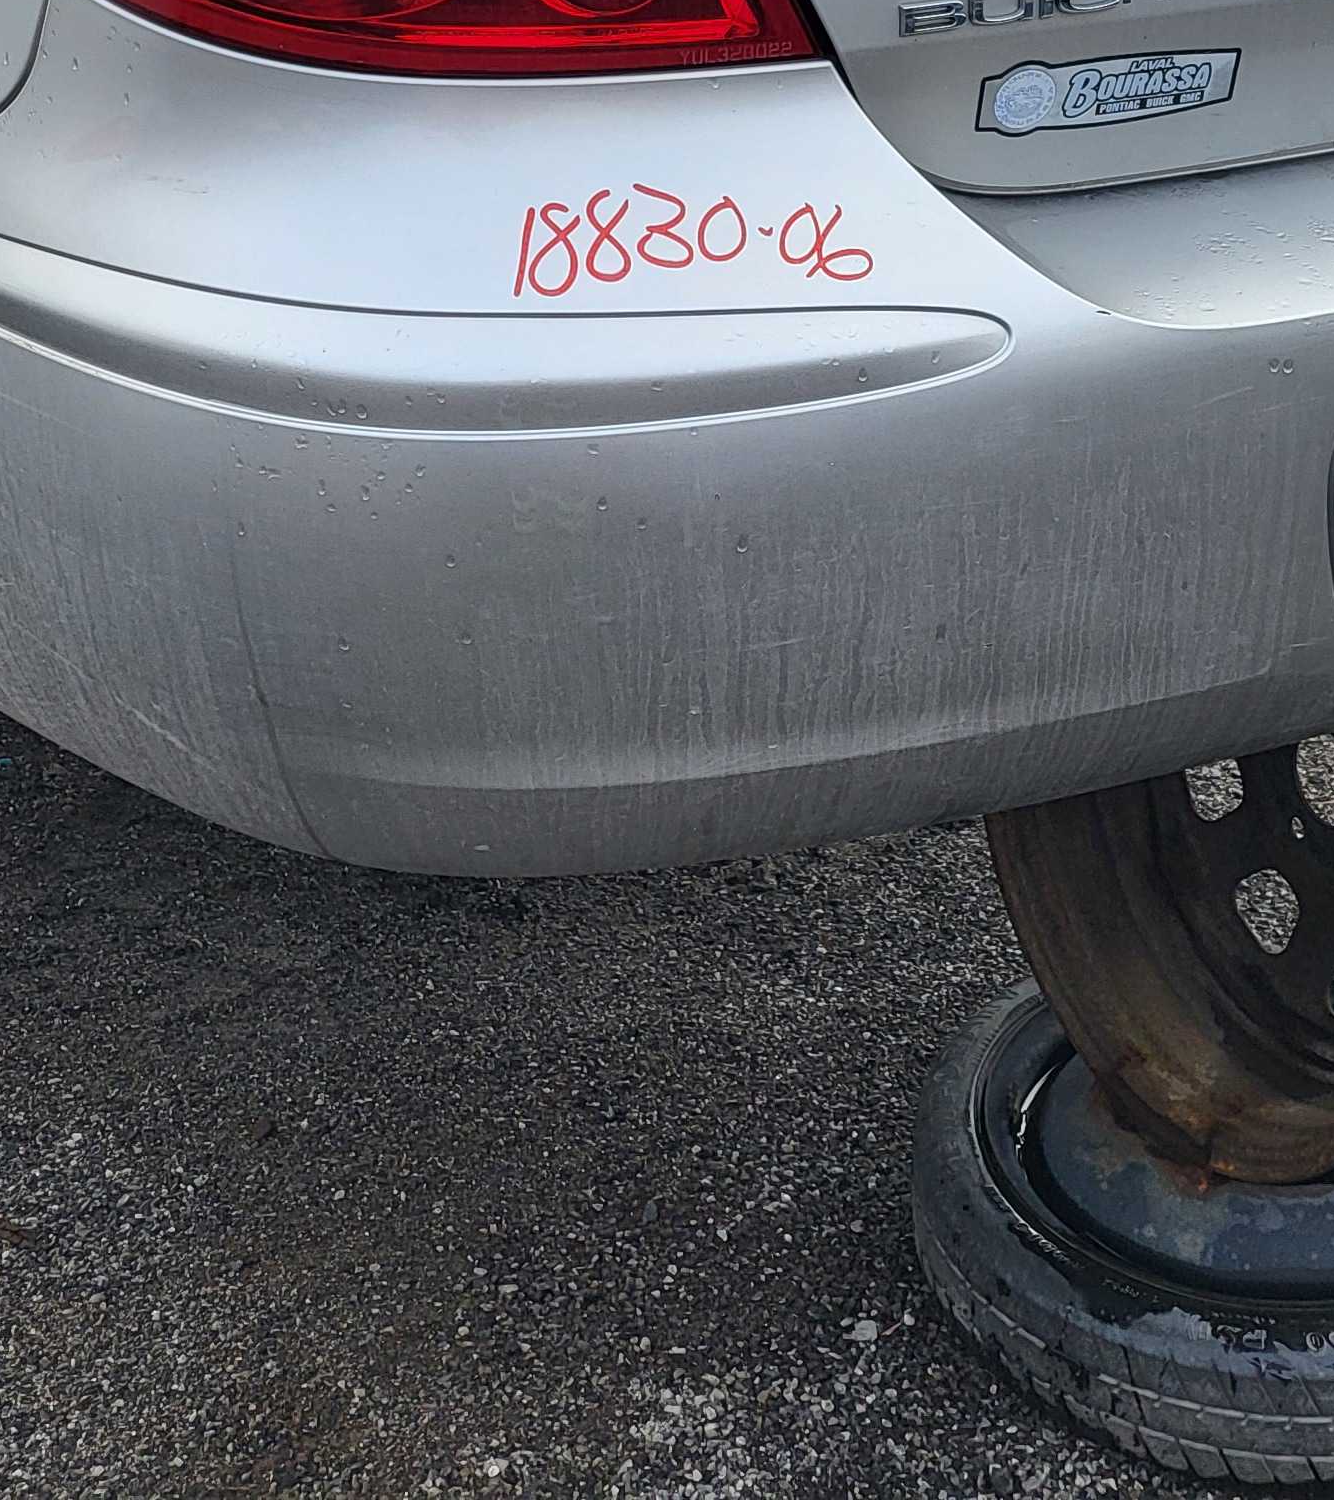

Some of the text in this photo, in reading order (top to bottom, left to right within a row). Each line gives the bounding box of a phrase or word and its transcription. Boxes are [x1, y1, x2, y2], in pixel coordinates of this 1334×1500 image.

[1129, 57, 1175, 74] LAVAL
[1062, 62, 1212, 118] BOURASSA
[1098, 99, 1141, 115] PONTIAC
[1145, 96, 1175, 109] BUICK
